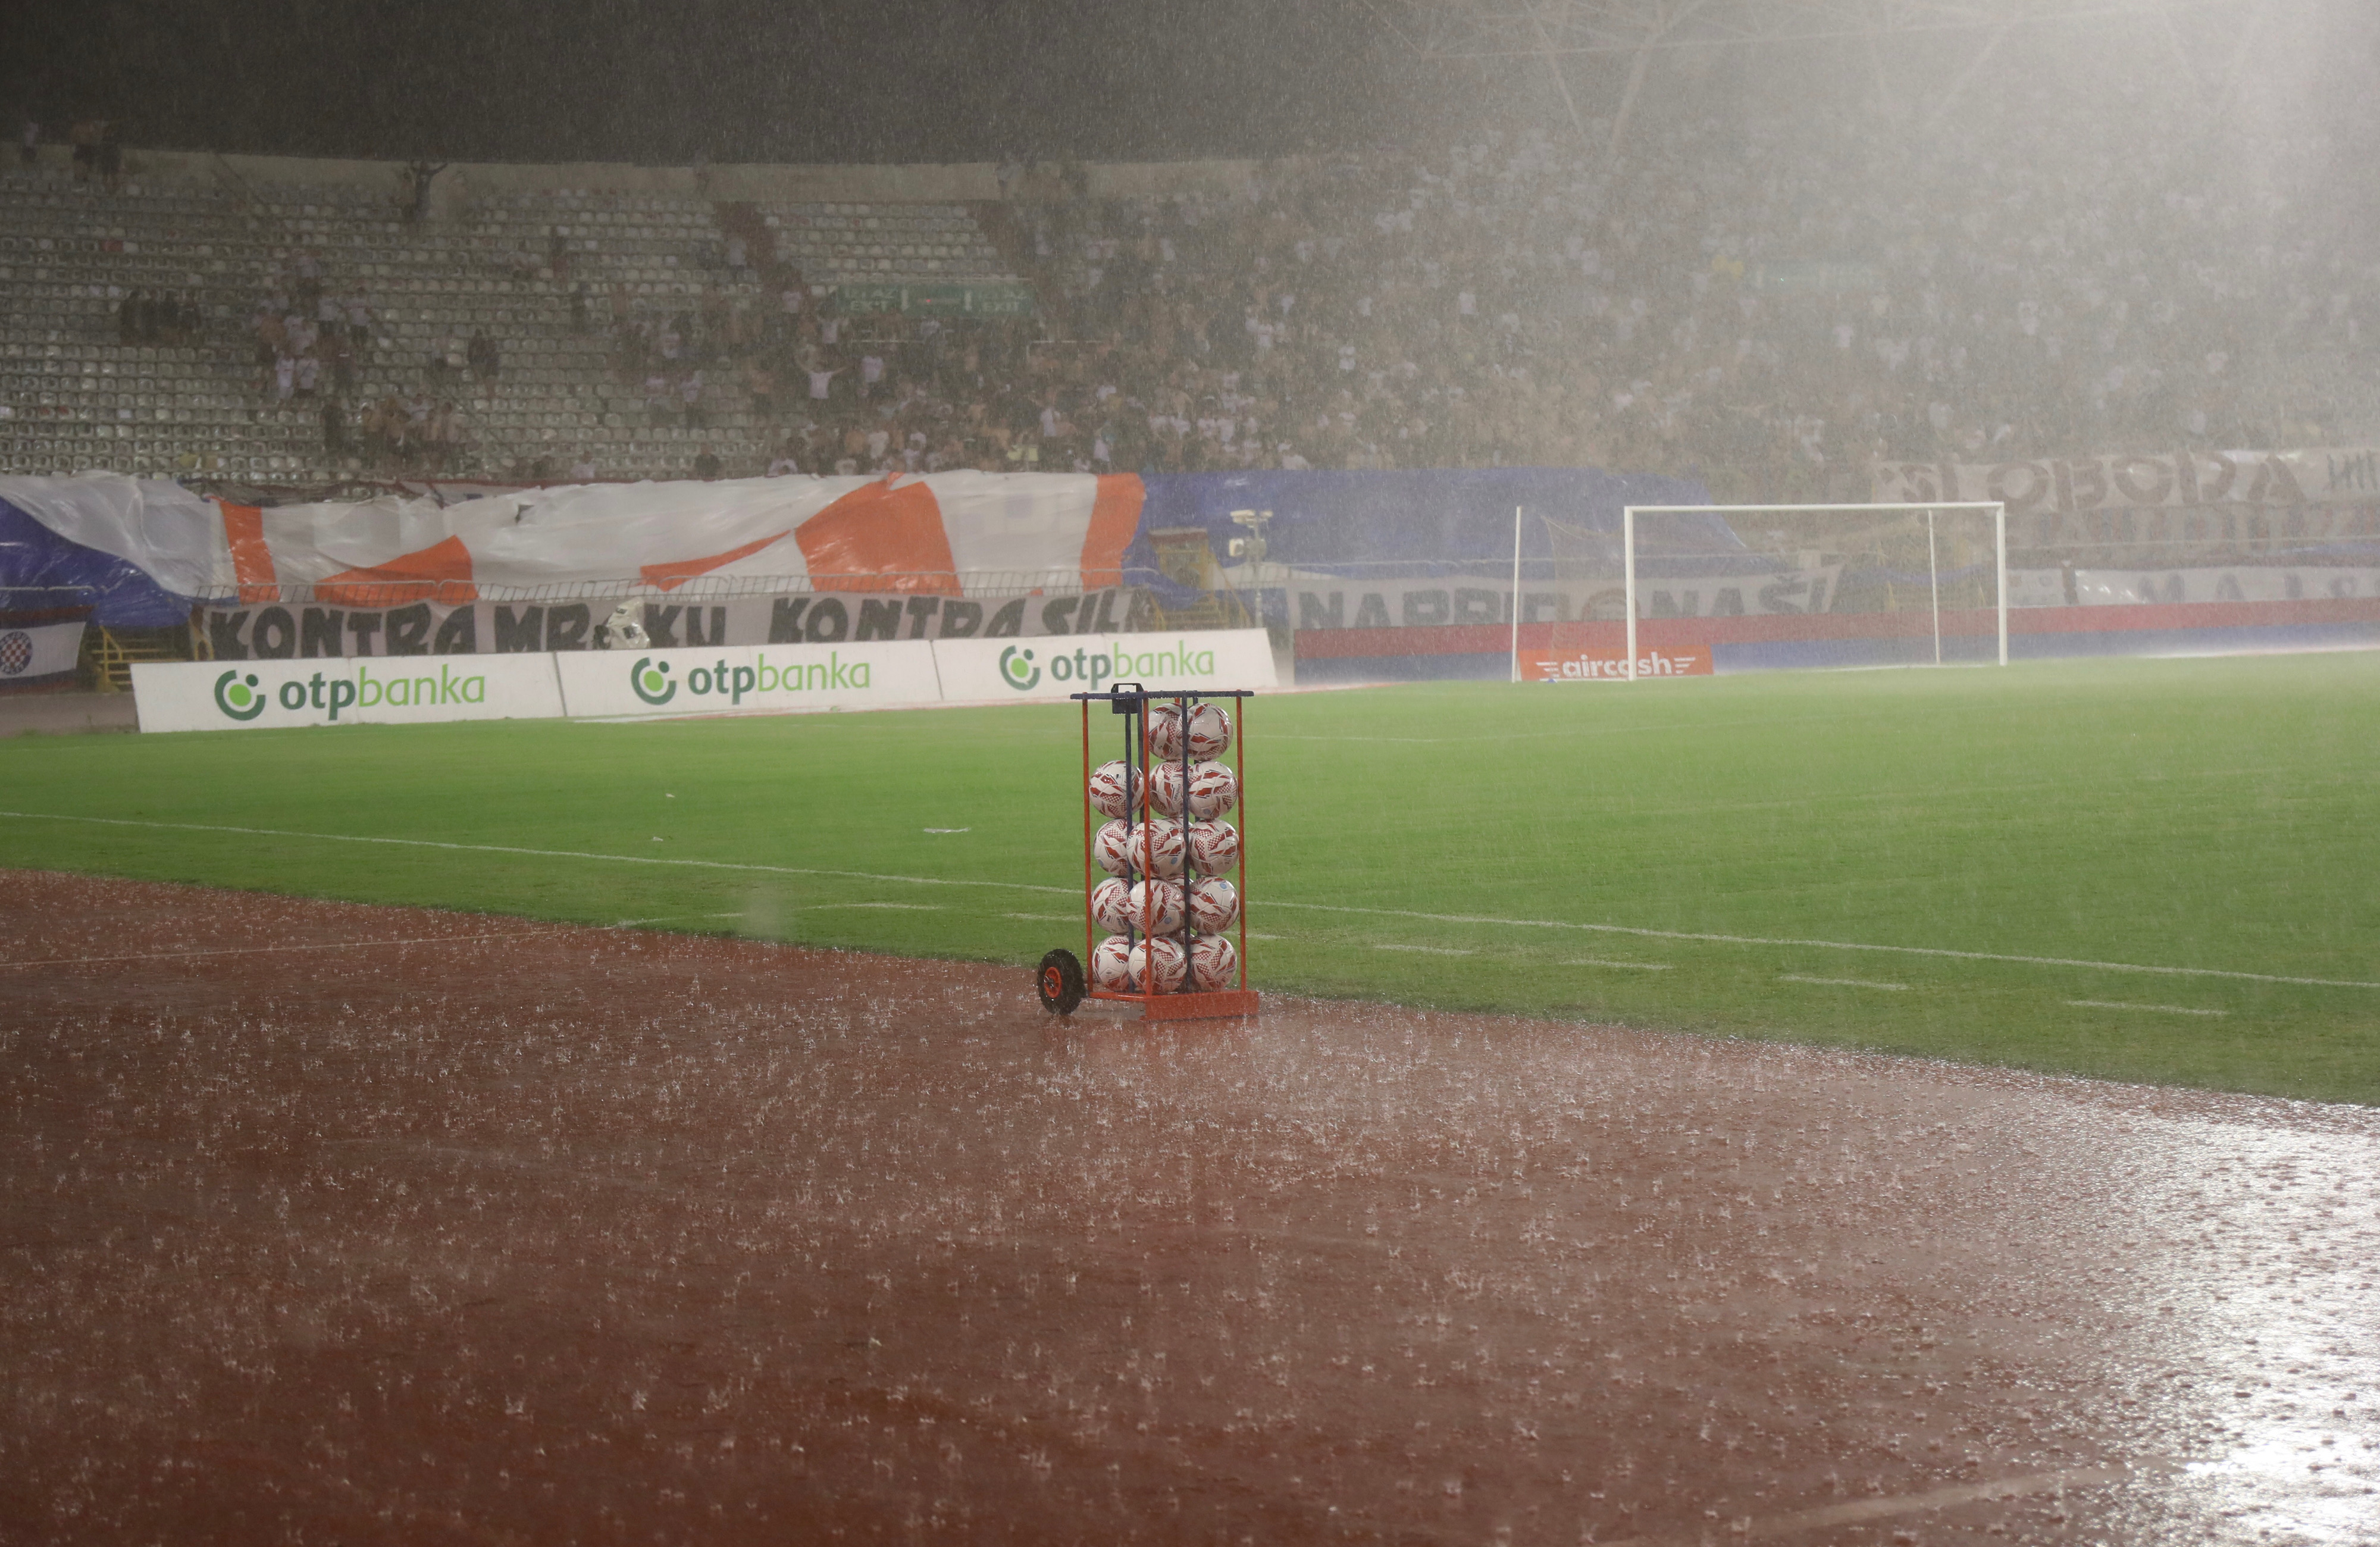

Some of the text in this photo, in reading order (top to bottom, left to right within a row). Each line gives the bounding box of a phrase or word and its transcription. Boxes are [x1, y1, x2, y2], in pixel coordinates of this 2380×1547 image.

[210, 602, 476, 660] KONTRA
[494, 602, 726, 653] MRKU
[768, 596, 1026, 644] KONTRA
